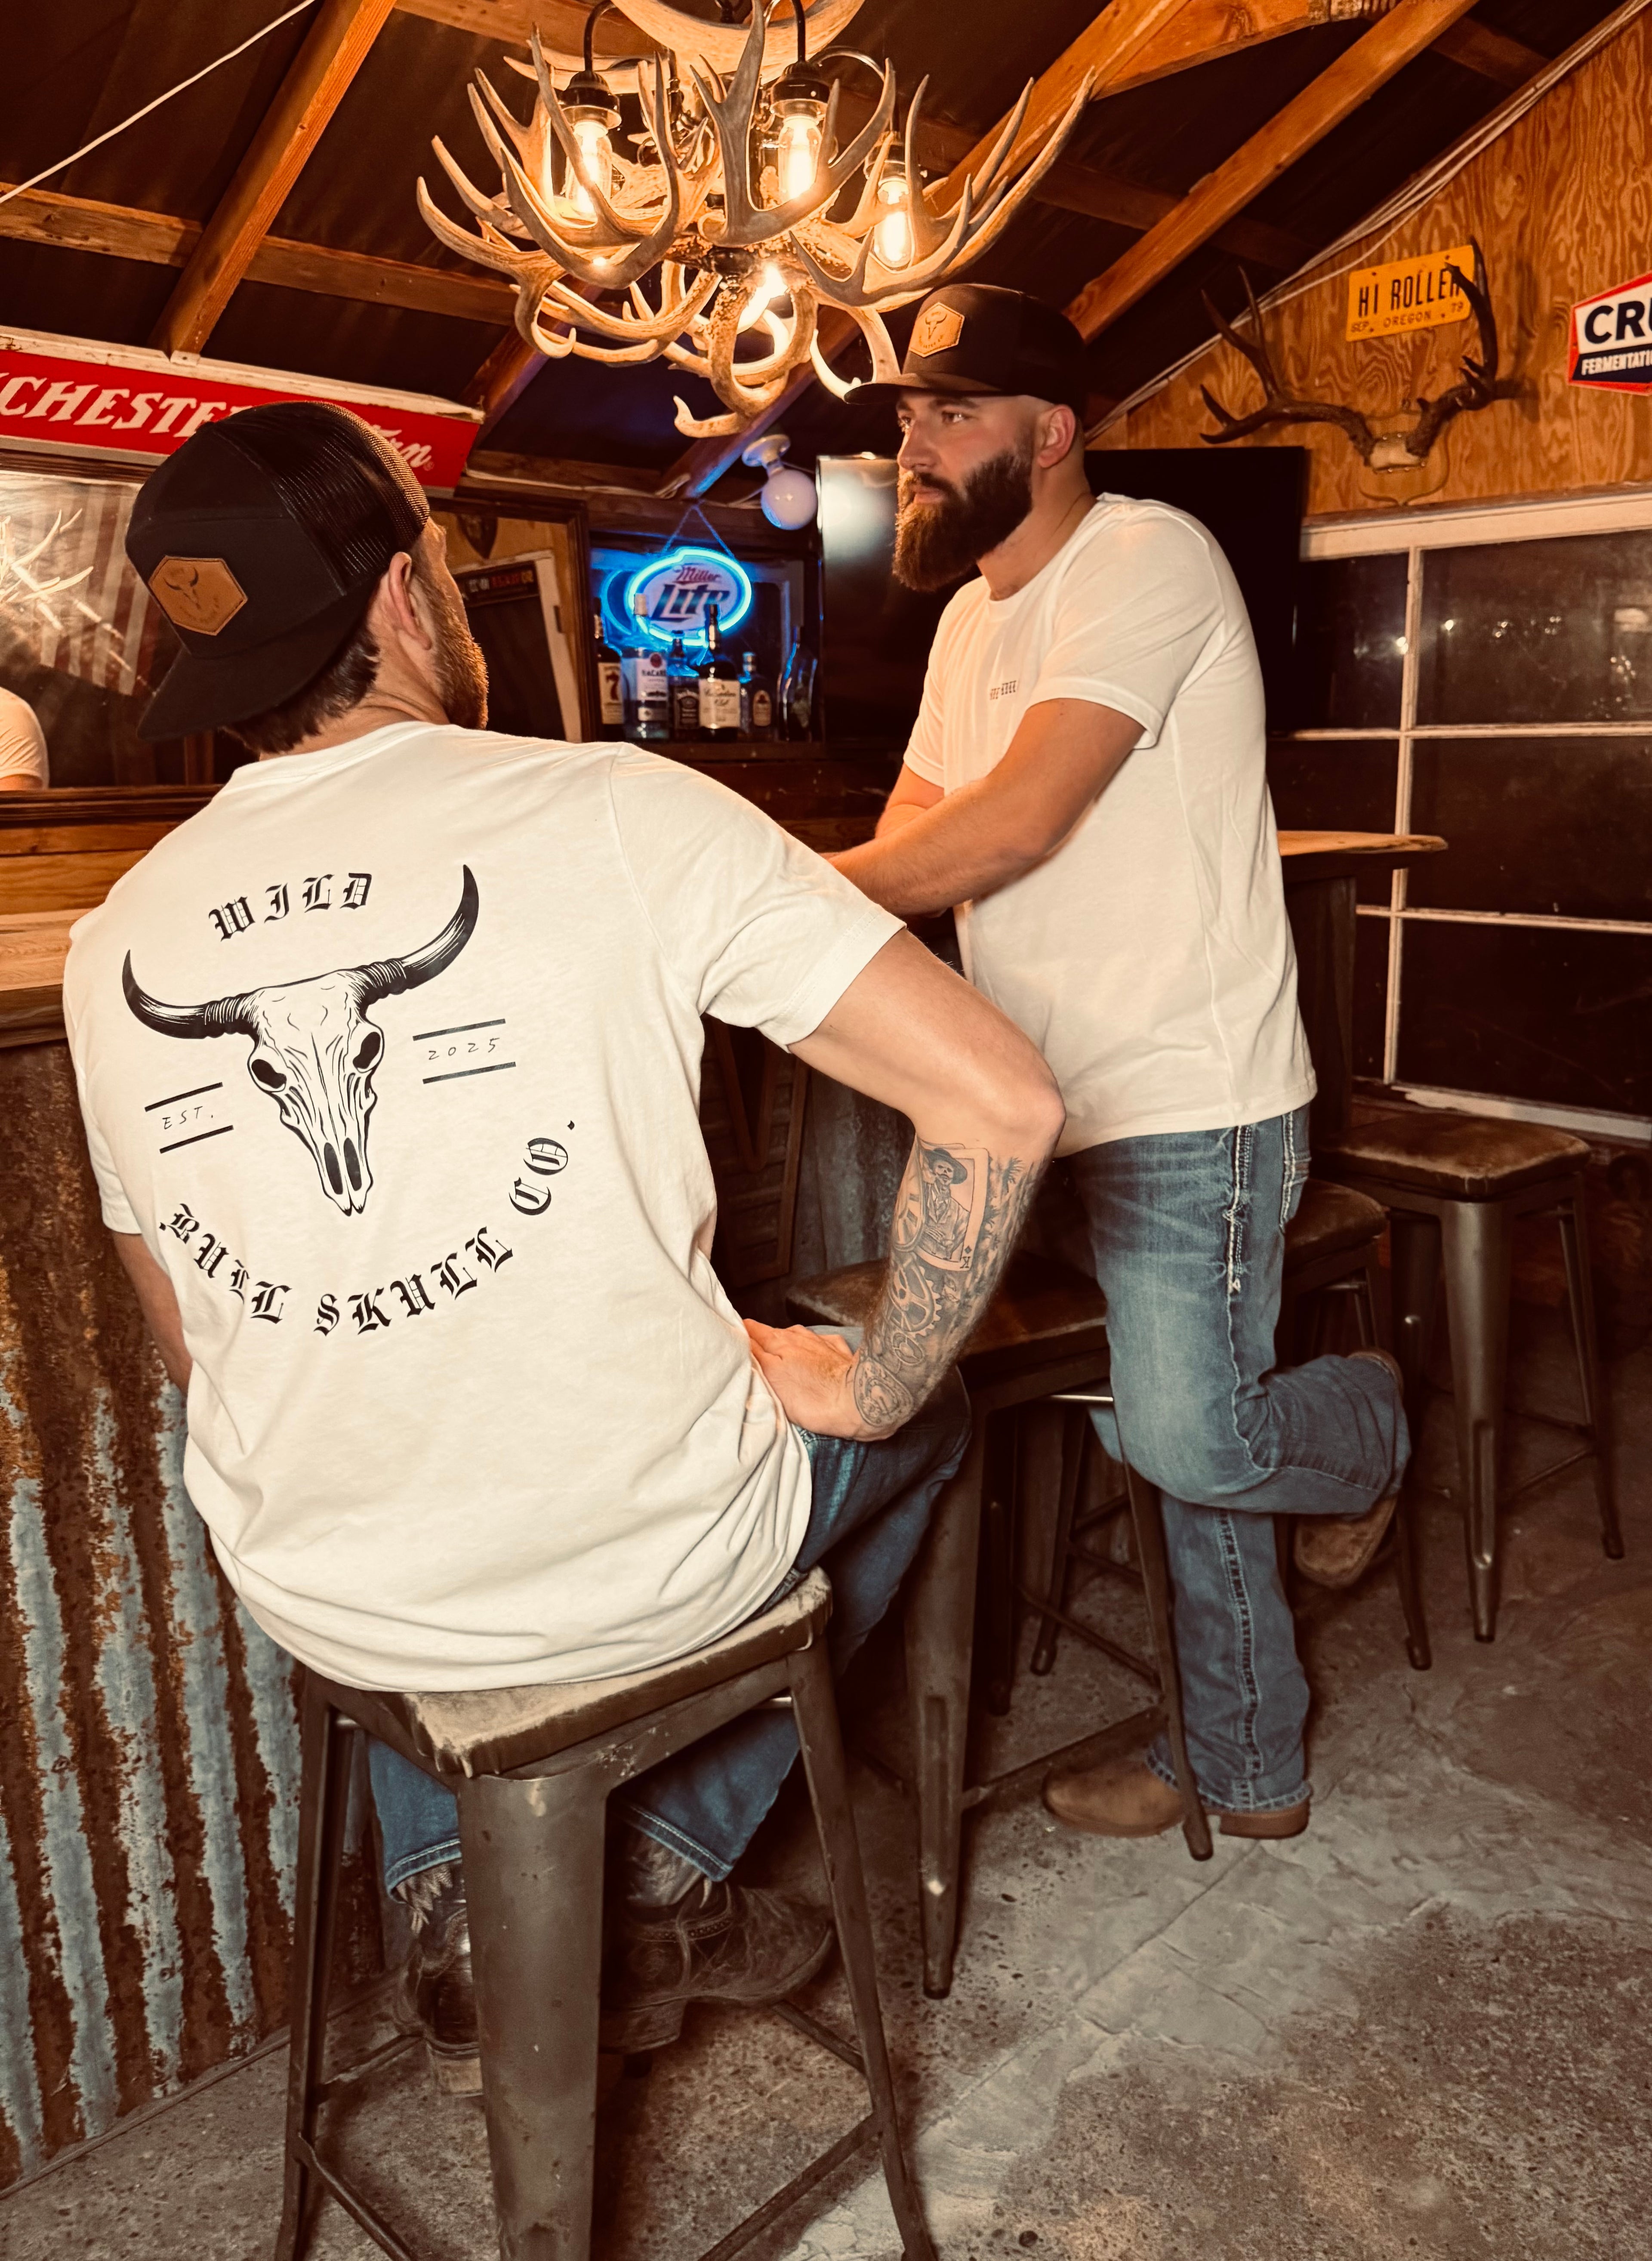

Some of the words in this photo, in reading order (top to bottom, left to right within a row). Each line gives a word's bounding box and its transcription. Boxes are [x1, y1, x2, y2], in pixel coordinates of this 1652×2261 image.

[1358, 284, 1378, 318] HI
[1383, 310, 1432, 328] OREGON
[1584, 297, 1652, 345] CR
[1581, 349, 1652, 376] FERMENTATI
[676, 565, 723, 583] Miller
[208, 873, 373, 941] WILD
[428, 1037, 500, 1060] 2025
[162, 1106, 213, 1130] EST.
[314, 1226, 513, 1336] SKULL
